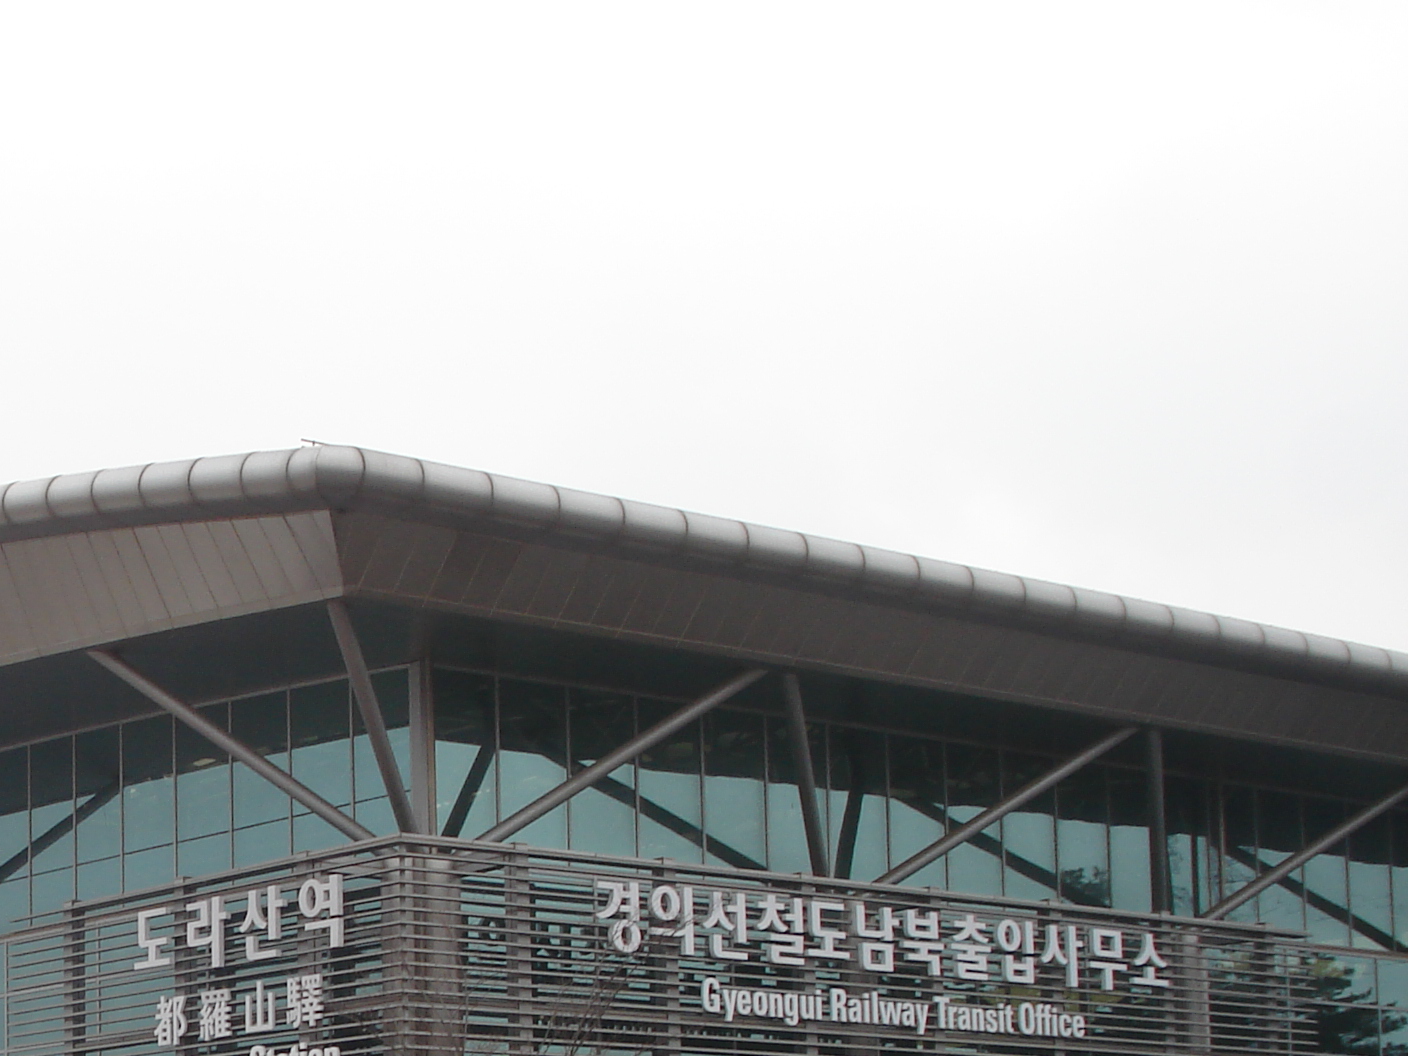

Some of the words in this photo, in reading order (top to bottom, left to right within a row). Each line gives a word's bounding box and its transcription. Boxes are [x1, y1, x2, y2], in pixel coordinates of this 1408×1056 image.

[133, 873, 344, 970] 도라산역
[595, 881, 1172, 991] 경의선철도남북출입사무소
[154, 973, 325, 1047] 都羅山驛
[701, 977, 823, 1026] Gyeongui
[829, 987, 929, 1035] Railway
[932, 996, 1014, 1034] Transit
[1018, 1002, 1086, 1038] Office
